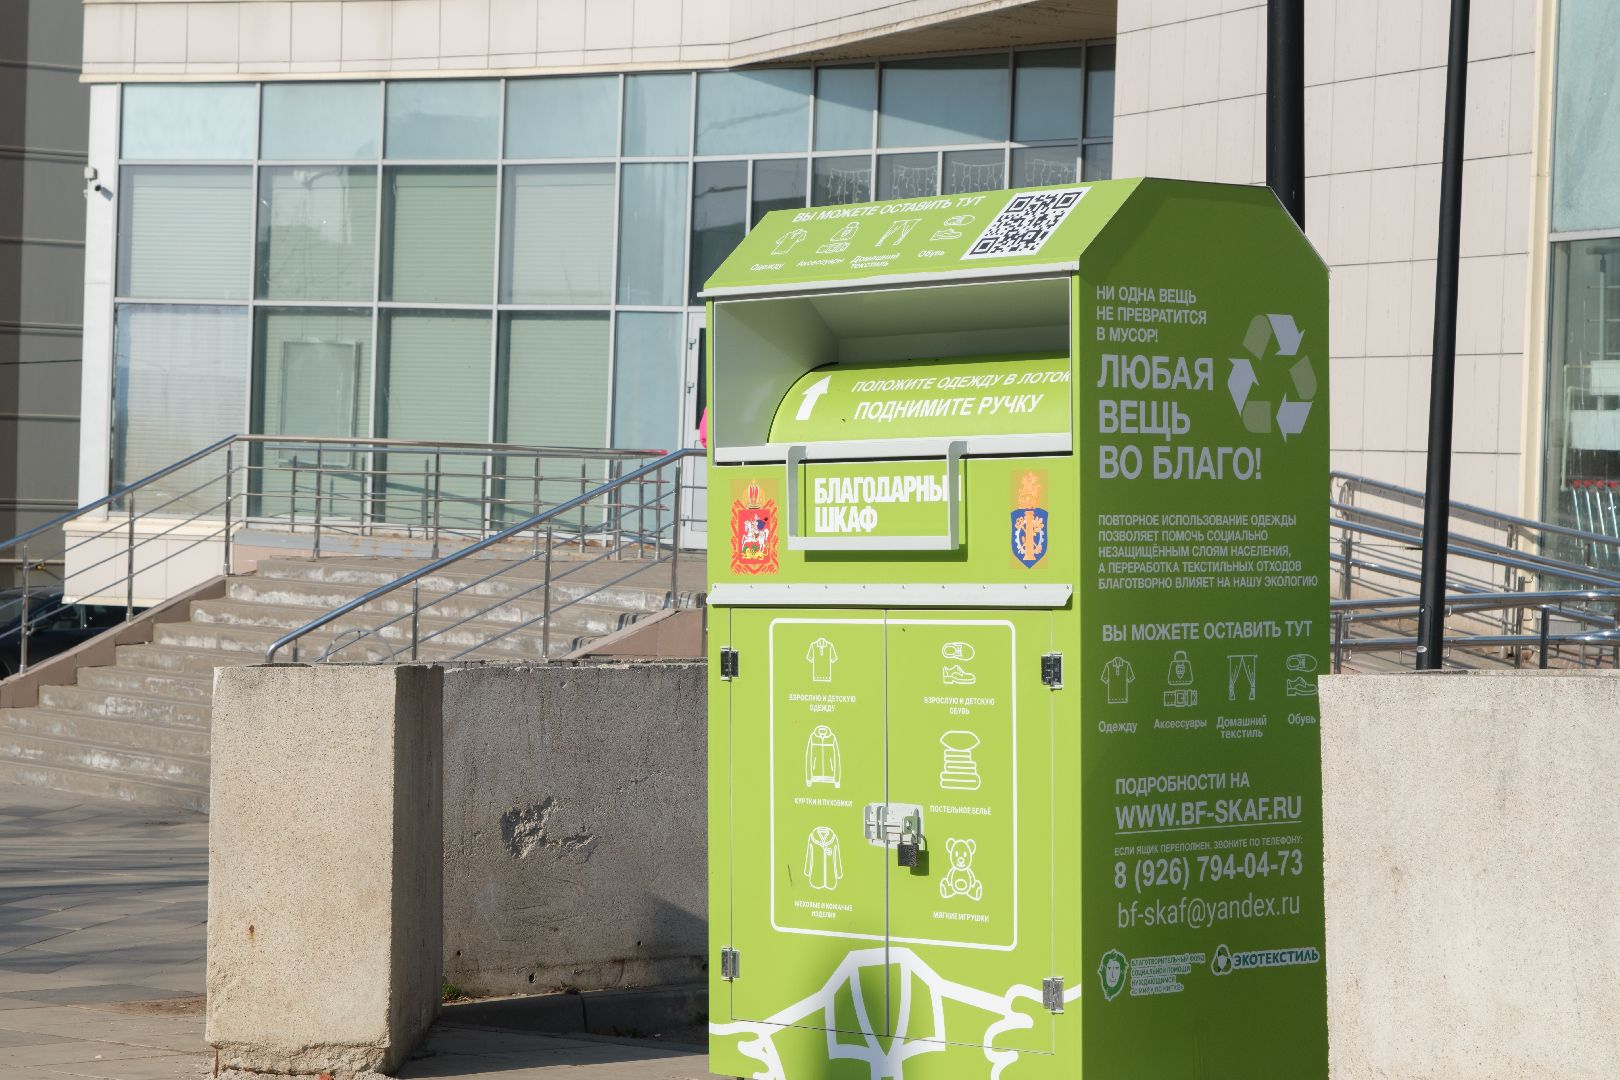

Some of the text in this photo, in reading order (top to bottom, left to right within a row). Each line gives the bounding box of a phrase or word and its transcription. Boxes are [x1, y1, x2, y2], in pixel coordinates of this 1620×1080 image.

[792, 195, 987, 223] ВЫ МОЖЕТЕ ОСТАВИТЬ ТУТ
[850, 253, 901, 264] Домашний
[918, 250, 945, 258] Обувь
[1096, 285, 1197, 306] НИ ОДНА ВЕЩЬ
[1096, 306, 1207, 325] НЕ ПРЕВРАТИТСЯ
[1096, 327, 1159, 343] В МУСОР!
[1097, 353, 1214, 391] ЛЮБАЯ
[851, 370, 1070, 393] ПОЛОЖИТЕ ОДЕЖДУ В ЛОТОК
[853, 393, 1044, 422] ПОДНИМИТЕ РУЧКУ
[1099, 399, 1191, 442] ВЕЩЬ
[1099, 445, 1262, 481] ВО БЛАГО!
[814, 474, 962, 504] БЛАГОДАРНЫ
[814, 505, 878, 533] ШКАФ
[1098, 514, 1297, 527] ПОВТОРНОЕ ИСПОЛЬЗОВАНИЕ ОДЕЖДЫ
[1098, 530, 1268, 543] ПОЗВОЛЯЕТ ПОМОЧЬ СОЦИАЛЬНО
[1192, 546, 1228, 557] СЛОЯМ
[1230, 545, 1292, 558] НАСЕЛЕНИЯ,
[1098, 560, 1303, 574] А ПЕРЕРАБОТКА ТЕКСТИЛЬНЫХ ОТХОДОВ
[1098, 575, 1318, 590] БЛАГОТВОРНО ВЛИЯЕТ НА НАШУ ЭКОЛОГИЮ
[1102, 620, 1313, 642] ВЫ МОЖЕТЕ ОСТАВИТЬ ТУТ
[809, 704, 836, 712] ОДЕЖДУ
[924, 696, 959, 704] ВЗРОСЛУЮ
[965, 697, 995, 706] ДЕТСКУЮ
[949, 707, 970, 715] ОБУВЬ
[1098, 720, 1138, 734] Одежду
[1153, 718, 1207, 730] Аксессуары
[1216, 715, 1267, 730] Домашний
[1287, 713, 1316, 726] Обувь
[1220, 729, 1263, 738] текстиль
[1116, 772, 1249, 796] ПОДРОБНОСТИ НА
[930, 805, 971, 815] ПОСТЕЛЬНОЕ
[1115, 796, 1302, 829] WWW.BF-SKAF.RU
[1114, 846, 1135, 856] ЕСЛИ
[1136, 845, 1159, 855] ЯЩИК
[1214, 839, 1248, 849] ЗВОНИТЕ
[1249, 838, 1260, 847] ПО
[1262, 835, 1303, 846] ТЕЛЕФОНУ:
[1114, 849, 1303, 894] 8 (926) 794-04-73
[933, 911, 990, 922] МЯГКИЕ ИГРУШКИ
[1118, 893, 1300, 929] bf-skaf@yandex.ru
[1234, 950, 1319, 967] ЭКОТЕКСТИЛЬ
